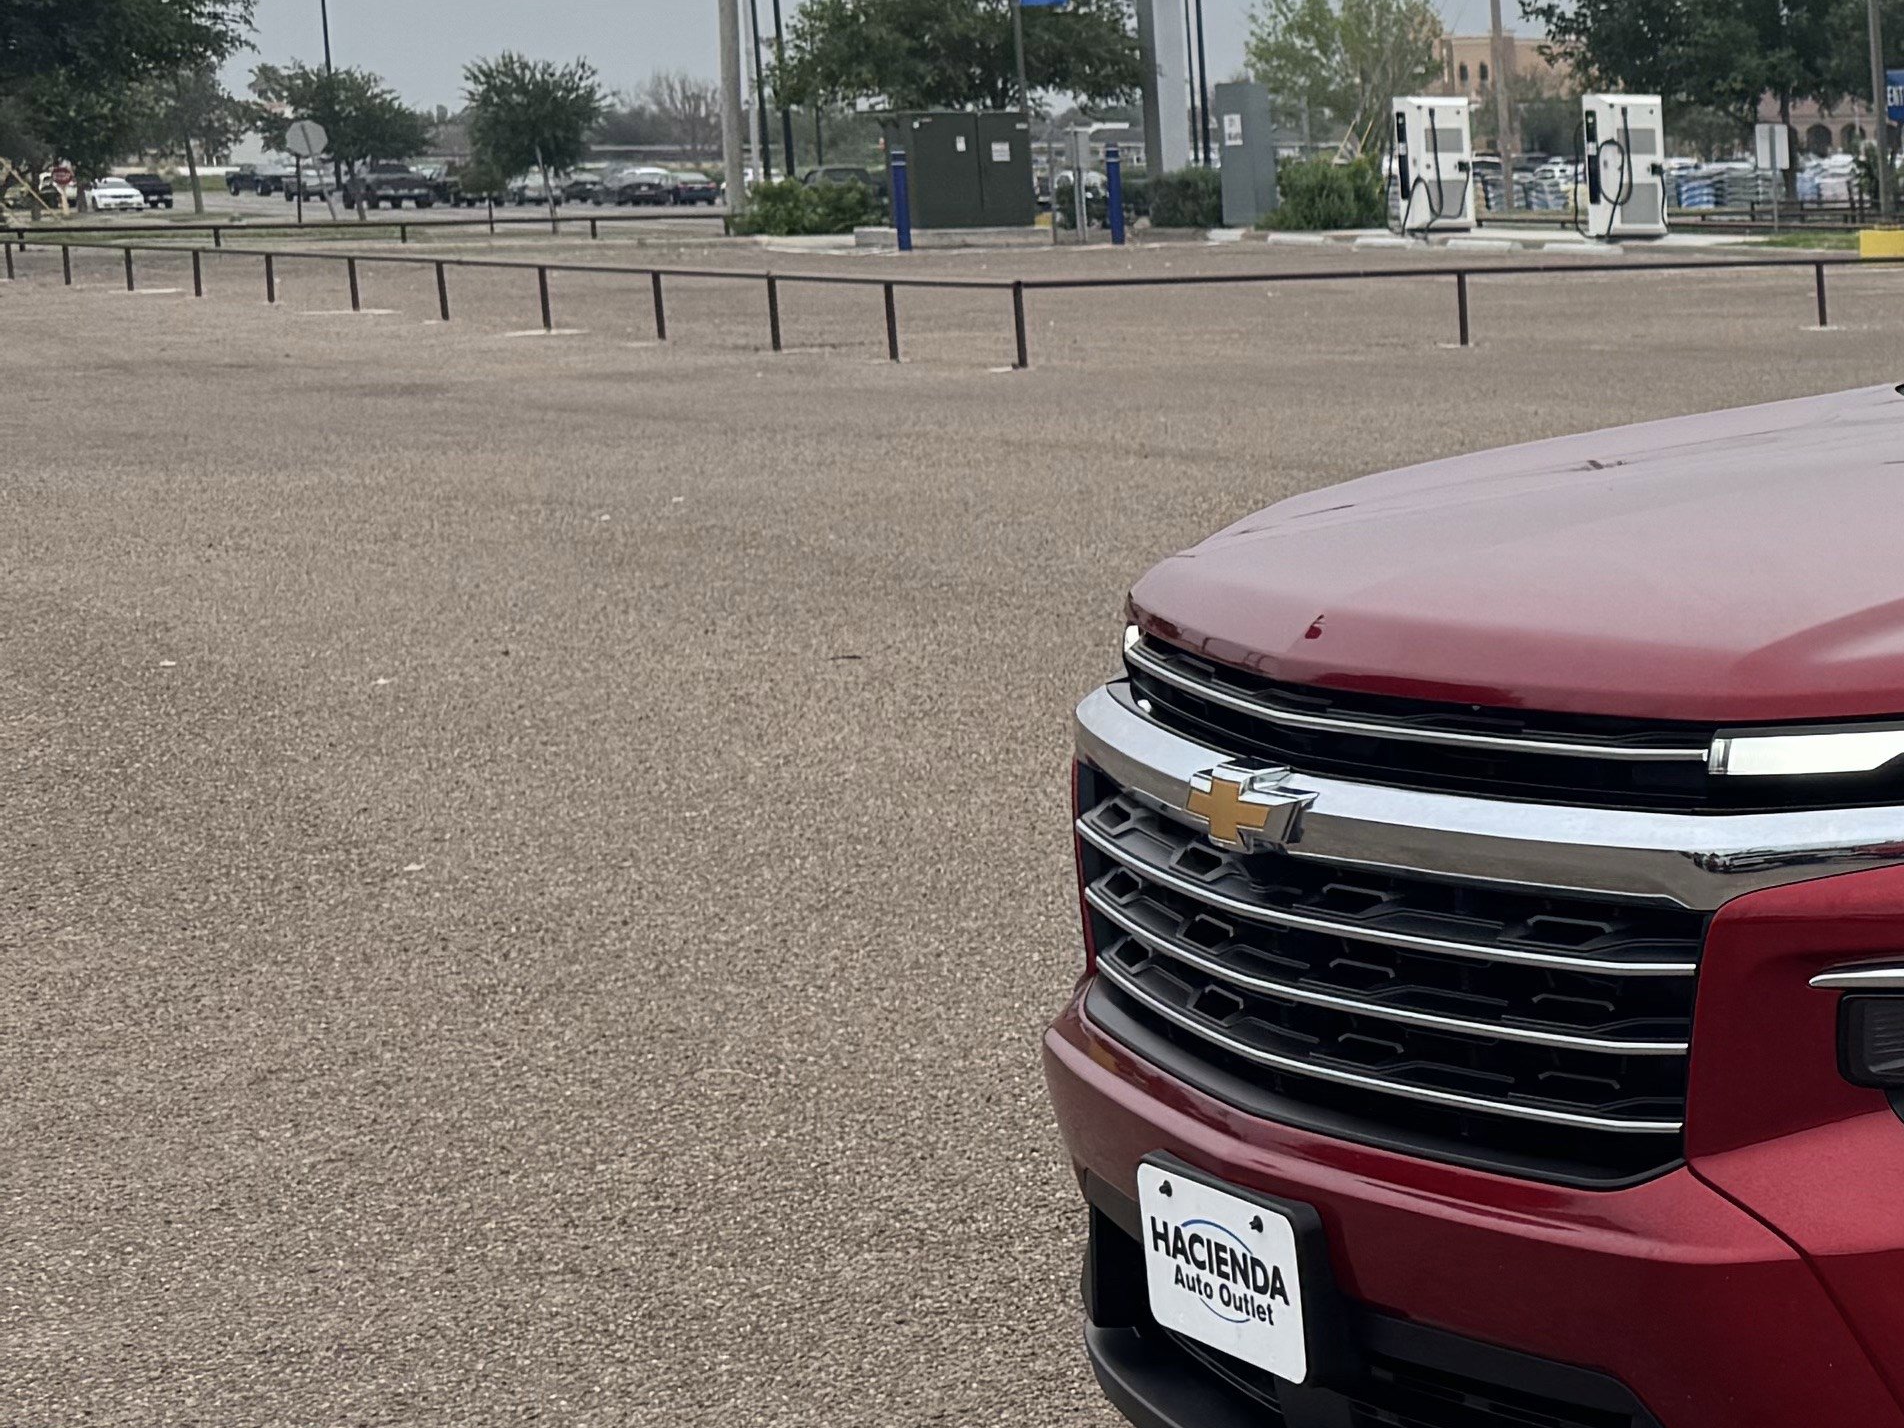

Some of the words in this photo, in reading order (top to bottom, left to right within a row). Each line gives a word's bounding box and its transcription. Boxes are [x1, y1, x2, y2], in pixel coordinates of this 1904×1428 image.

[1150, 1215, 1290, 1306] HACIENDA
[1174, 1264, 1214, 1300] Auto
[1219, 1283, 1275, 1326] Outlet
